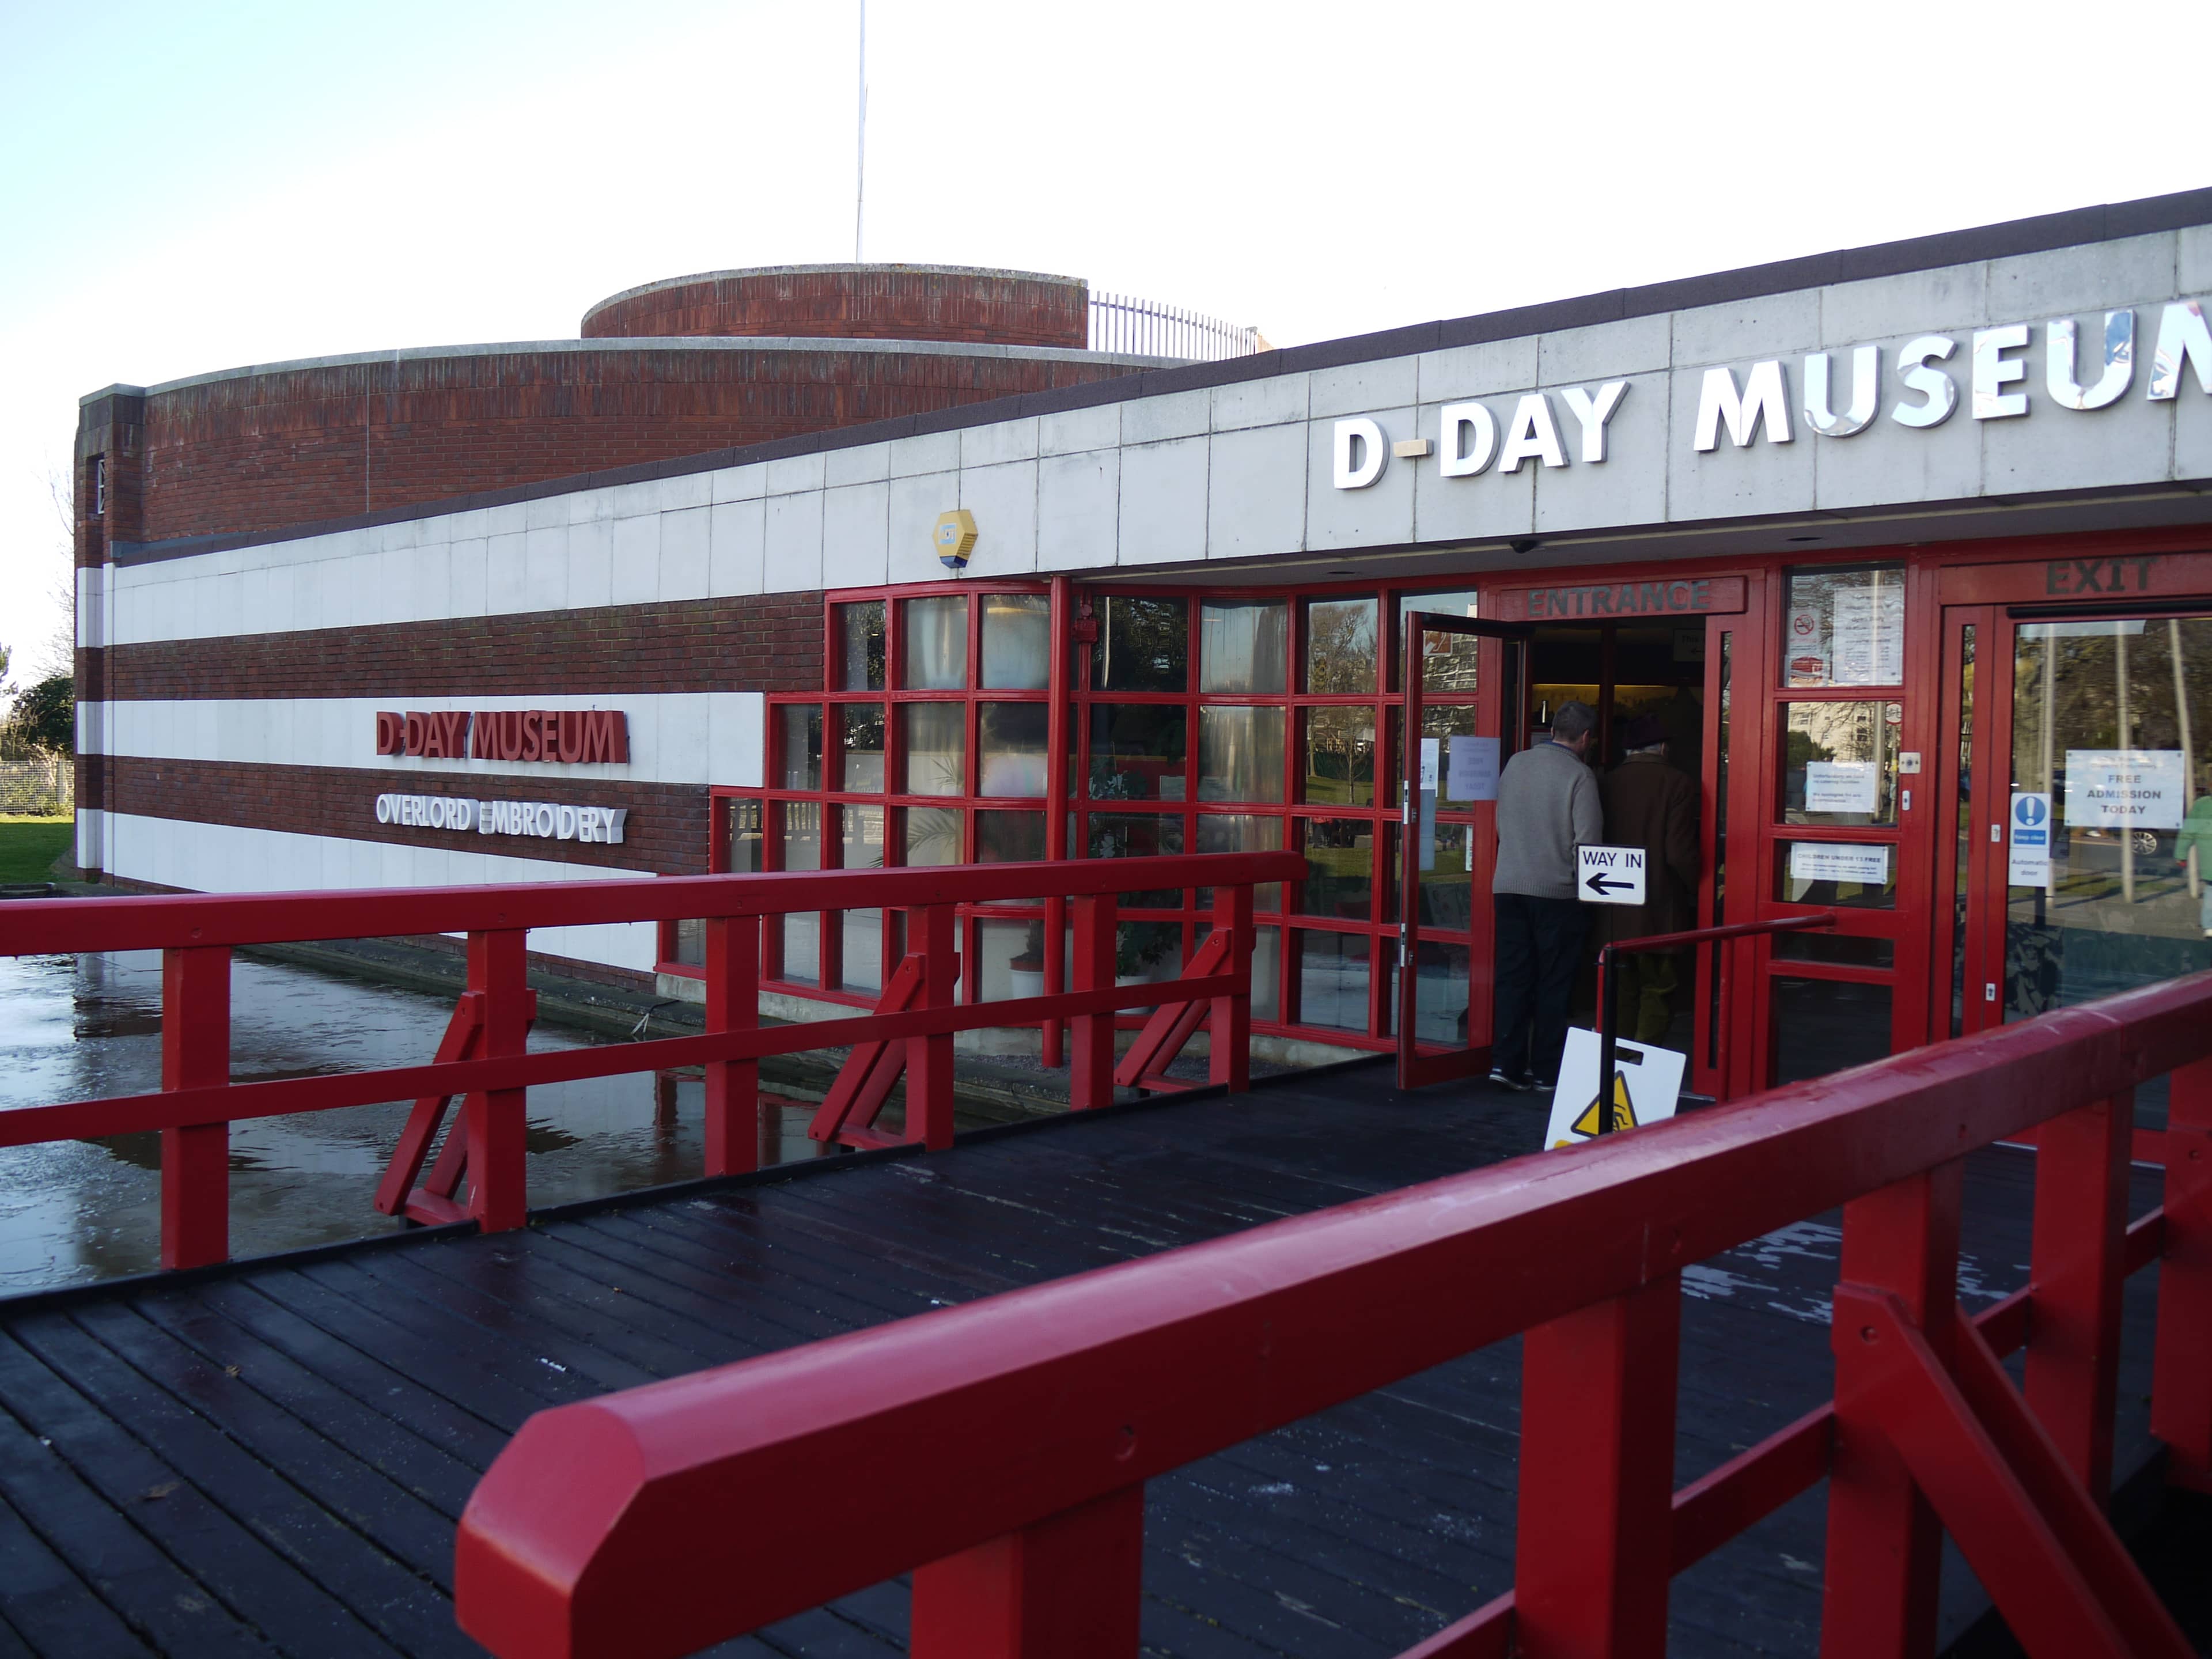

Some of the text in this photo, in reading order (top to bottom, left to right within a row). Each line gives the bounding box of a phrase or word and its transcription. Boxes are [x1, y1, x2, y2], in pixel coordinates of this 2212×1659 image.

[1334, 381, 1631, 490] D-DAY
[2047, 556, 2160, 594] EXIT
[1528, 580, 1710, 616] ENTRANCE
[376, 710, 630, 763] D-DAY MUSEUM
[2108, 775, 2142, 784] FREE
[2087, 790, 2162, 800] ADMISSION
[376, 794, 480, 831] OVERLORD
[2101, 805, 2146, 815] TODAY
[1582, 850, 1642, 869] WAY IN
[2012, 858, 2049, 866] Automatic
